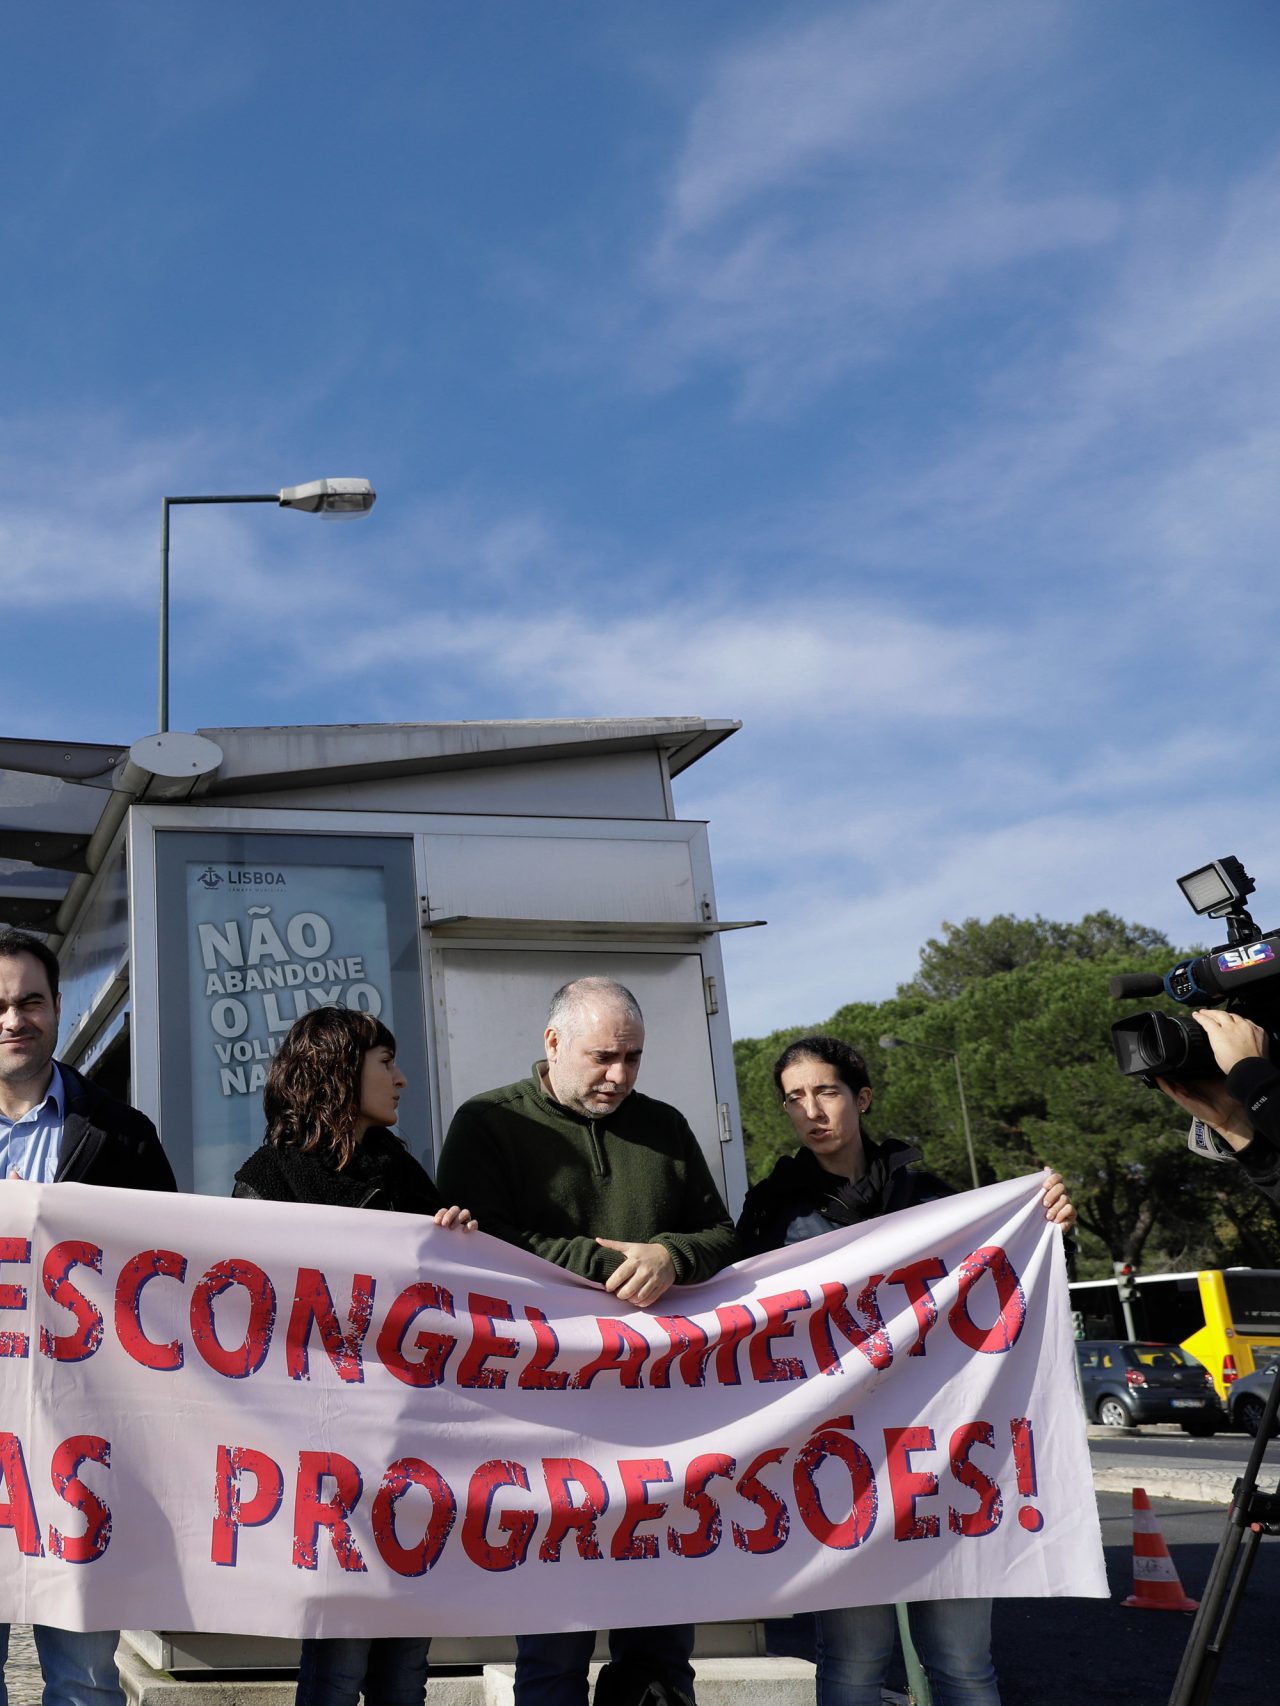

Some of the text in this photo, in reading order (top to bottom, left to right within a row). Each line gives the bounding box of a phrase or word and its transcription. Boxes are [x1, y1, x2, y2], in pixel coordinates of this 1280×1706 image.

[228, 870, 286, 885] LISBOA
[198, 906, 332, 970] NÃO
[205, 957, 366, 996] ABANDONE
[210, 997, 249, 1038] O
[210, 1414, 1044, 1578] PROGRESSÕES!
